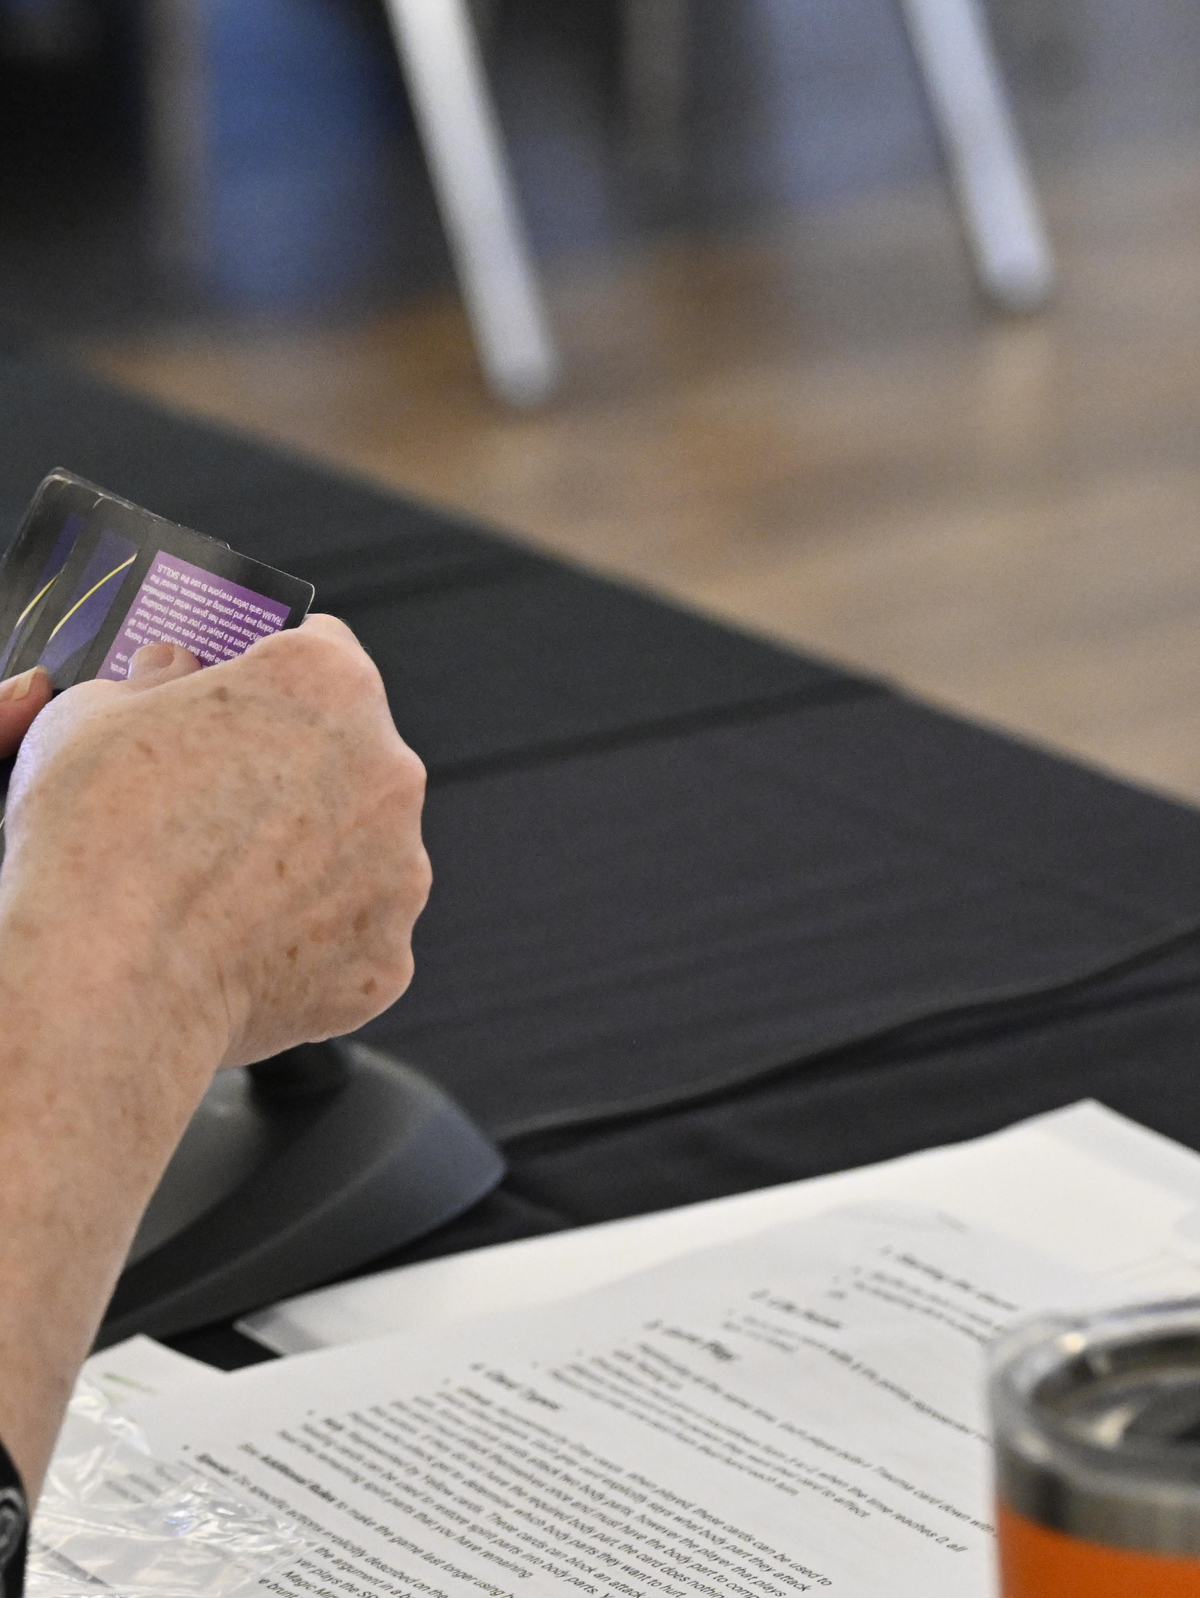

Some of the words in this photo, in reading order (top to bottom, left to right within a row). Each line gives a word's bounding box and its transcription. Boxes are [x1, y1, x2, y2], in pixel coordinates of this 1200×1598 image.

[157, 563, 180, 580] SKILLS.
[149, 574, 160, 584] the
[159, 578, 179, 591] reveal
[180, 573, 190, 584] the
[189, 578, 201, 587] use
[141, 584, 175, 602] confirmation
[200, 583, 208, 592] to
[207, 585, 233, 601] everyone
[173, 598, 192, 610] verbal
[205, 598, 213, 606] at
[211, 599, 234, 615] pointing
[232, 597, 250, 610] before
[134, 607, 151, 620] head
[168, 609, 188, 622] choice
[191, 606, 209, 618] given
[232, 610, 244, 620] and
[248, 604, 263, 615] cards
[150, 615, 166, 625] your
[186, 618, 201, 628] your
[207, 613, 219, 624] has
[243, 614, 258, 625] away
[261, 610, 284, 626] TRAUMA
[135, 621, 149, 630] you
[146, 626, 162, 637] card
[163, 620, 176, 630] put
[173, 625, 182, 633] or
[198, 623, 207, 631] of
[218, 618, 242, 633] everyone
[181, 628, 196, 639] eyes
[206, 626, 225, 638] player
[194, 635, 209, 644] your
[207, 640, 223, 651] close
[227, 635, 234, 643] at
[232, 638, 248, 649] point
[199, 649, 216, 662] plays
[432, 1525, 456, 1538] you
[454, 1535, 482, 1551] have
[591, 1512, 623, 1528] must
[618, 1525, 648, 1540] have
[644, 1538, 666, 1550] the
[662, 1547, 693, 1564] body
[686, 1562, 718, 1576] part
[712, 1574, 729, 1583] to
[673, 1515, 703, 1531] what
[698, 1529, 726, 1545] body
[722, 1544, 753, 1558] part
[748, 1557, 776, 1572] they
[772, 1572, 811, 1592] attack
[374, 1525, 394, 1537] the
[388, 1536, 424, 1554] game
[420, 1552, 446, 1566] last
[440, 1563, 478, 1581] longer
[473, 1580, 505, 1597] using
[489, 1538, 523, 1555] parts
[520, 1553, 544, 1565] into
[540, 1562, 570, 1578] body
[516, 1532, 548, 1549] cards
[544, 1548, 568, 1559] can
[564, 1557, 597, 1573] block
[593, 1572, 611, 1582] an
[542, 1525, 571, 1541] body
[566, 1539, 599, 1555] parts
[596, 1552, 623, 1567] they
[620, 1564, 652, 1581] want
[646, 1578, 662, 1587] to
[635, 1514, 681, 1539] however
[678, 1537, 700, 1549] the
[693, 1548, 734, 1567] player
[730, 1566, 758, 1581] that
[749, 1580, 786, 1598] plays
[722, 1525, 755, 1542] cards
[752, 1542, 776, 1554] can
[772, 1553, 792, 1563] be
[788, 1562, 823, 1579] used
[816, 1577, 832, 1586] to
[313, 1546, 335, 1559] the
[331, 1558, 384, 1585] argument
[378, 1583, 394, 1591] in
[617, 1543, 639, 1554] the
[635, 1553, 667, 1568] card
[659, 1566, 691, 1582] does
[281, 1570, 317, 1590] Magic
[364, 1556, 419, 1584] described
[412, 1582, 431, 1591] on
[308, 1568, 343, 1585] plays
[338, 1582, 360, 1593] the
